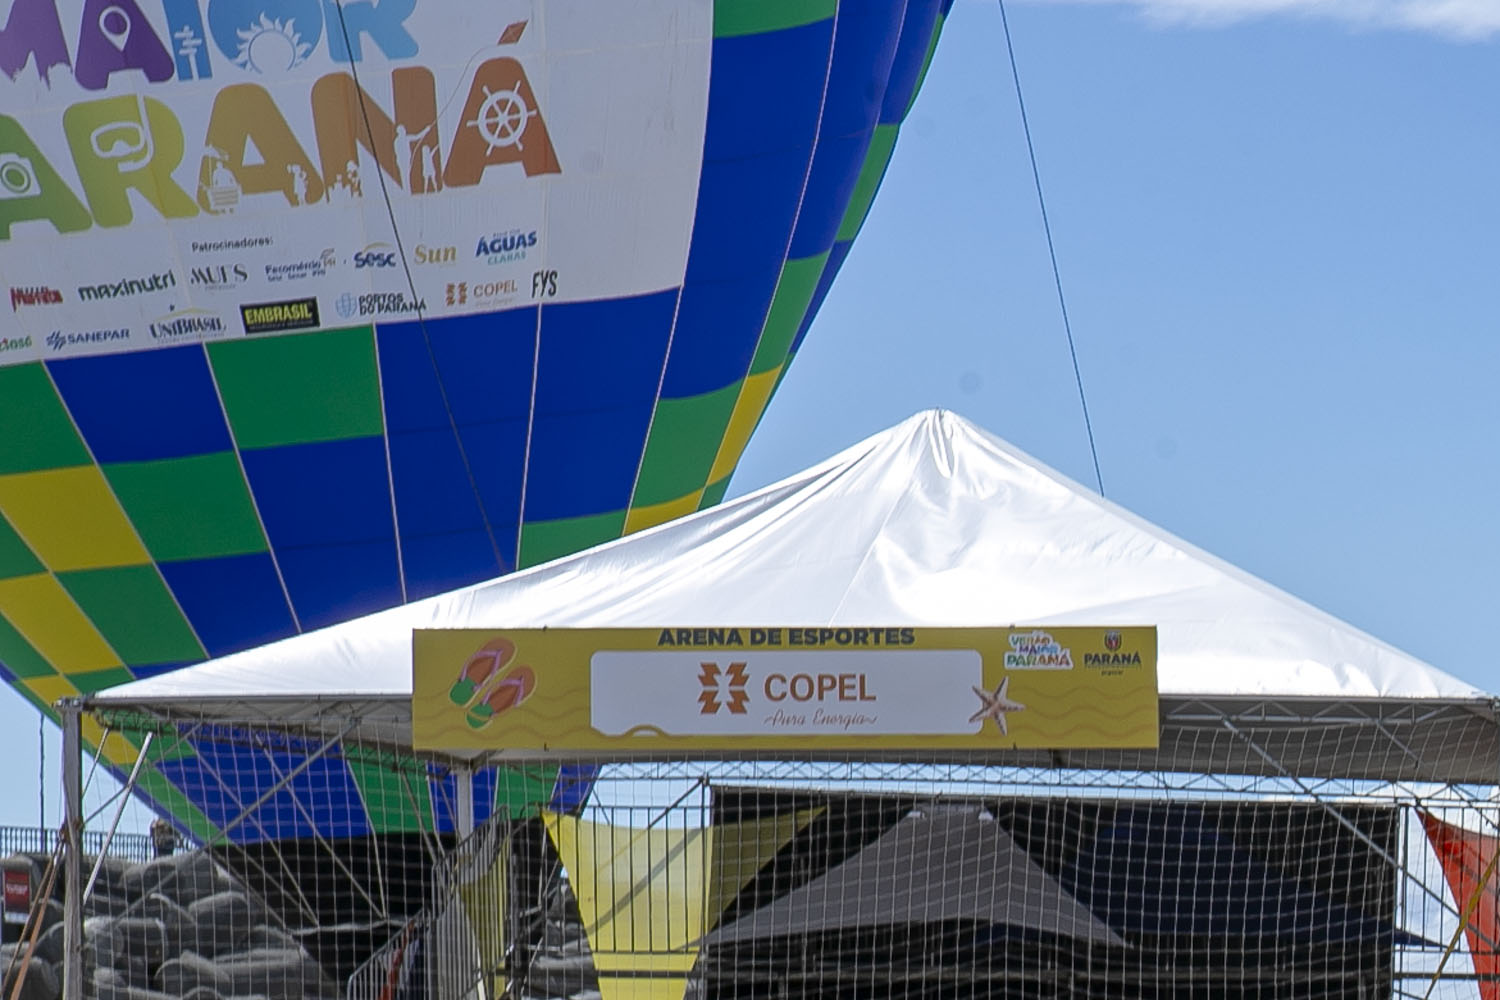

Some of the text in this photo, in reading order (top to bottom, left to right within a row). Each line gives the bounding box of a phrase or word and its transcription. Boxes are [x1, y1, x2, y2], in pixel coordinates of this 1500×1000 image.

[476, 231, 537, 257] ÁGUAS
[78, 270, 176, 301] maxinutri
[414, 245, 457, 264] Sun
[474, 269, 558, 299] COPEL FYS
[68, 329, 130, 345] SANEPAR
[244, 303, 312, 325] EMBRASIL
[658, 628, 915, 646] ARENA DE ESPORTES
[1084, 651, 1141, 665] PARANÁ
[764, 673, 877, 702] COPEL
